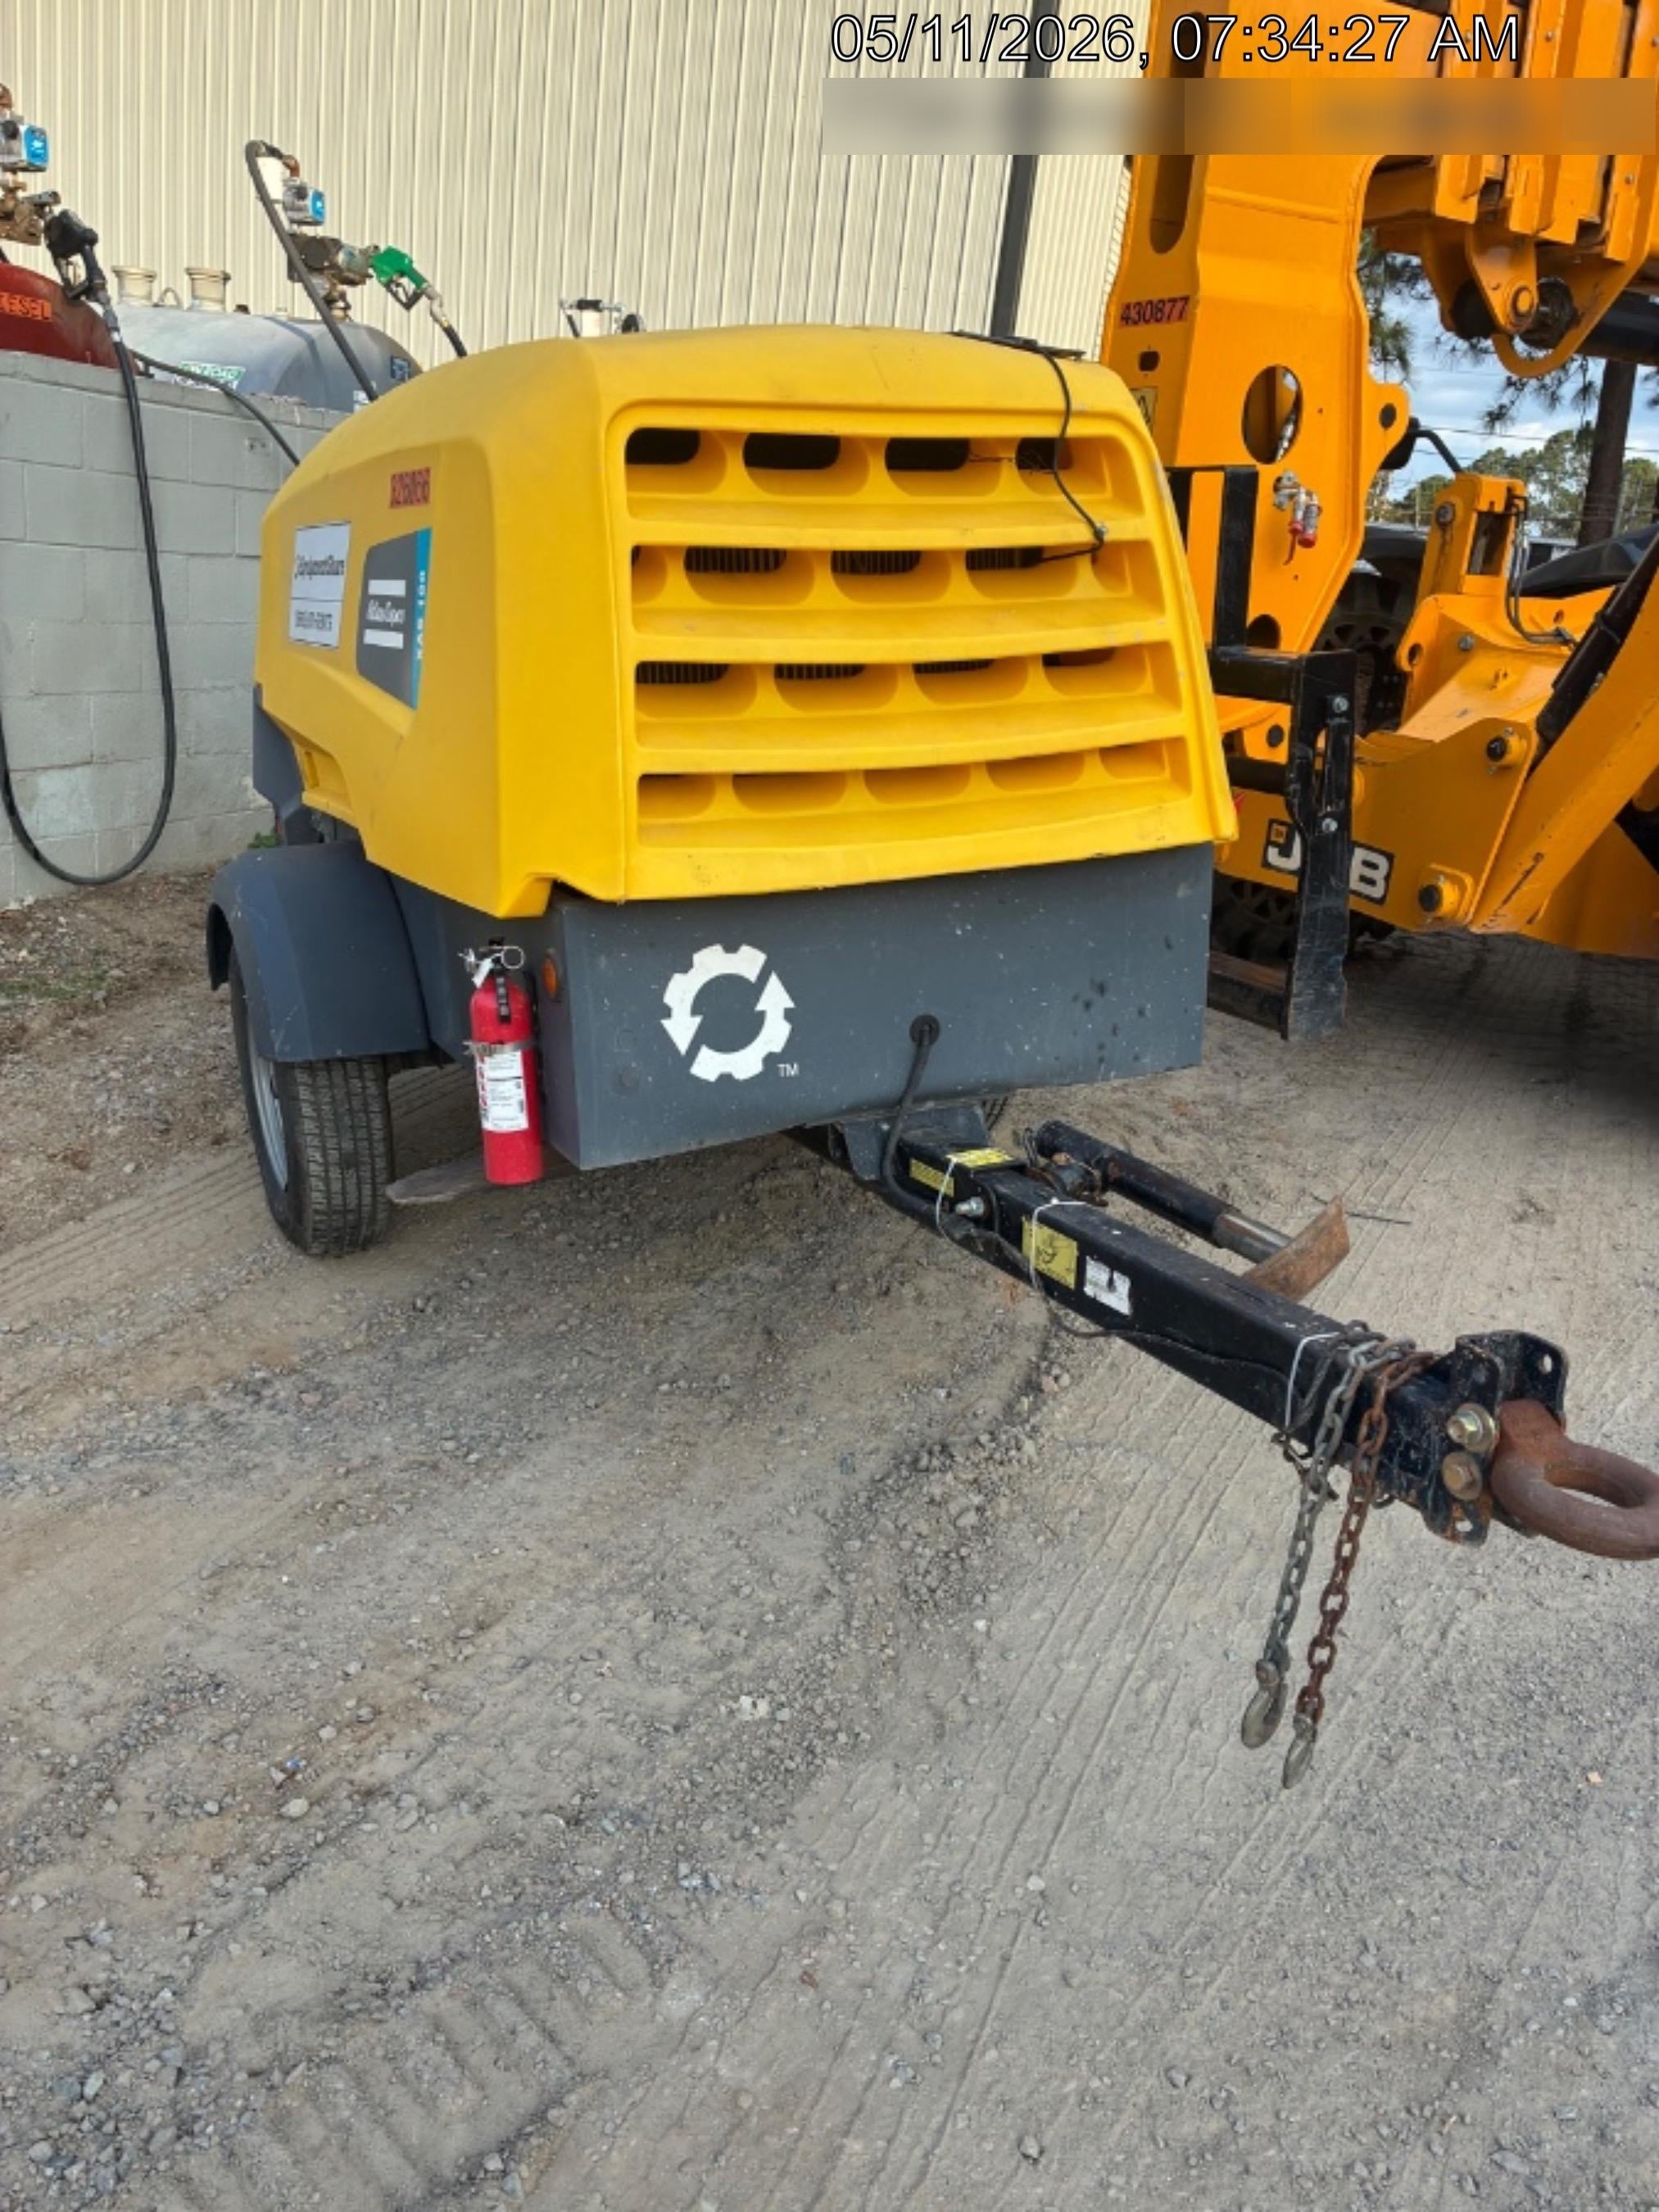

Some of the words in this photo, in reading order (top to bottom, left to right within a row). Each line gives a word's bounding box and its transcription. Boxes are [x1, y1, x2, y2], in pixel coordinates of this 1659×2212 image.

[1121, 296, 1190, 325] 430877
[1267, 823, 1390, 899] JB
[777, 1063, 800, 1077] TM
